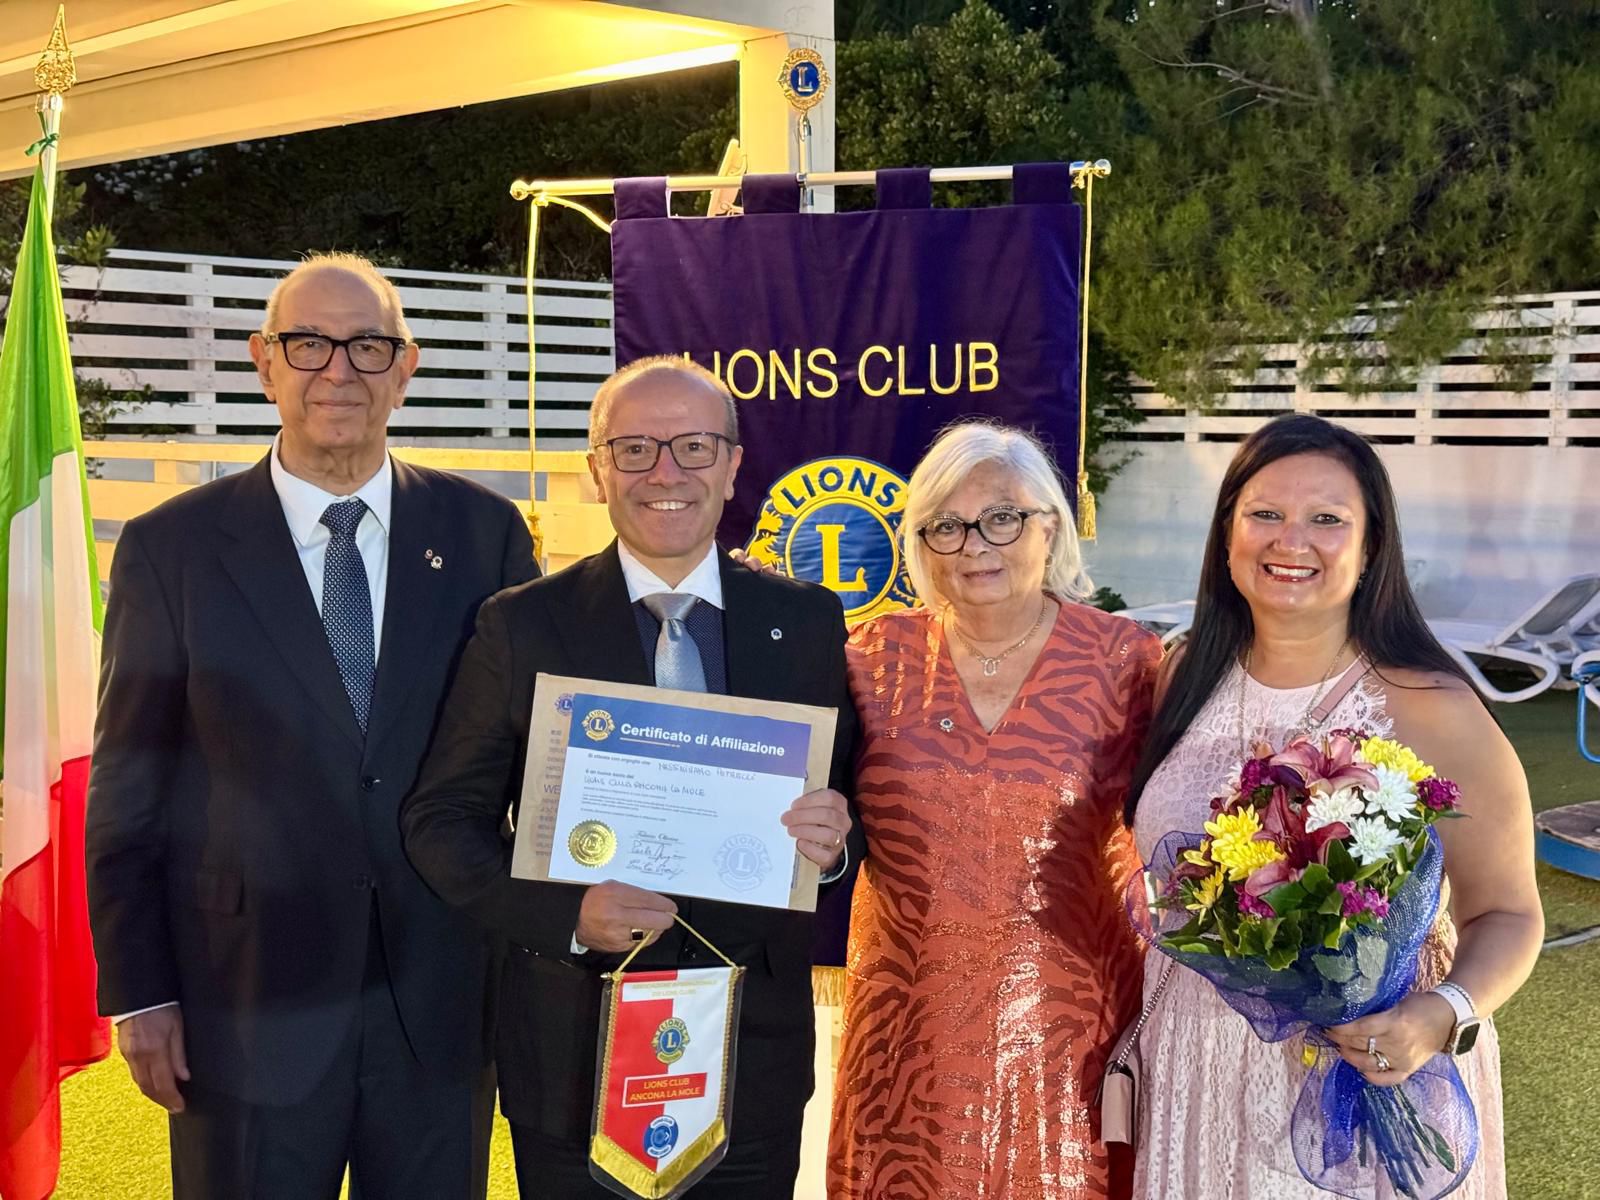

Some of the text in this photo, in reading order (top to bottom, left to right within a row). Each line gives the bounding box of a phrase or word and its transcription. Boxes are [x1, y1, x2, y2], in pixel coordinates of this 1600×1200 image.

[797, 66, 813, 92] L
[683, 342, 999, 400] IONS CLUB
[780, 466, 901, 510] LIONS
[815, 524, 868, 592] L
[594, 719, 603, 731] L
[621, 723, 692, 744] Certificato
[695, 734, 708, 746] di
[711, 736, 785, 757] Affiliazione
[727, 835, 762, 851] LIONS
[735, 852, 750, 873] L
[660, 1019, 686, 1031] LIONS
[666, 1031, 677, 1049] L
[644, 1078, 690, 1089] LIONS CLUB
[629, 1087, 701, 1102] ANCONA LA MOLE
